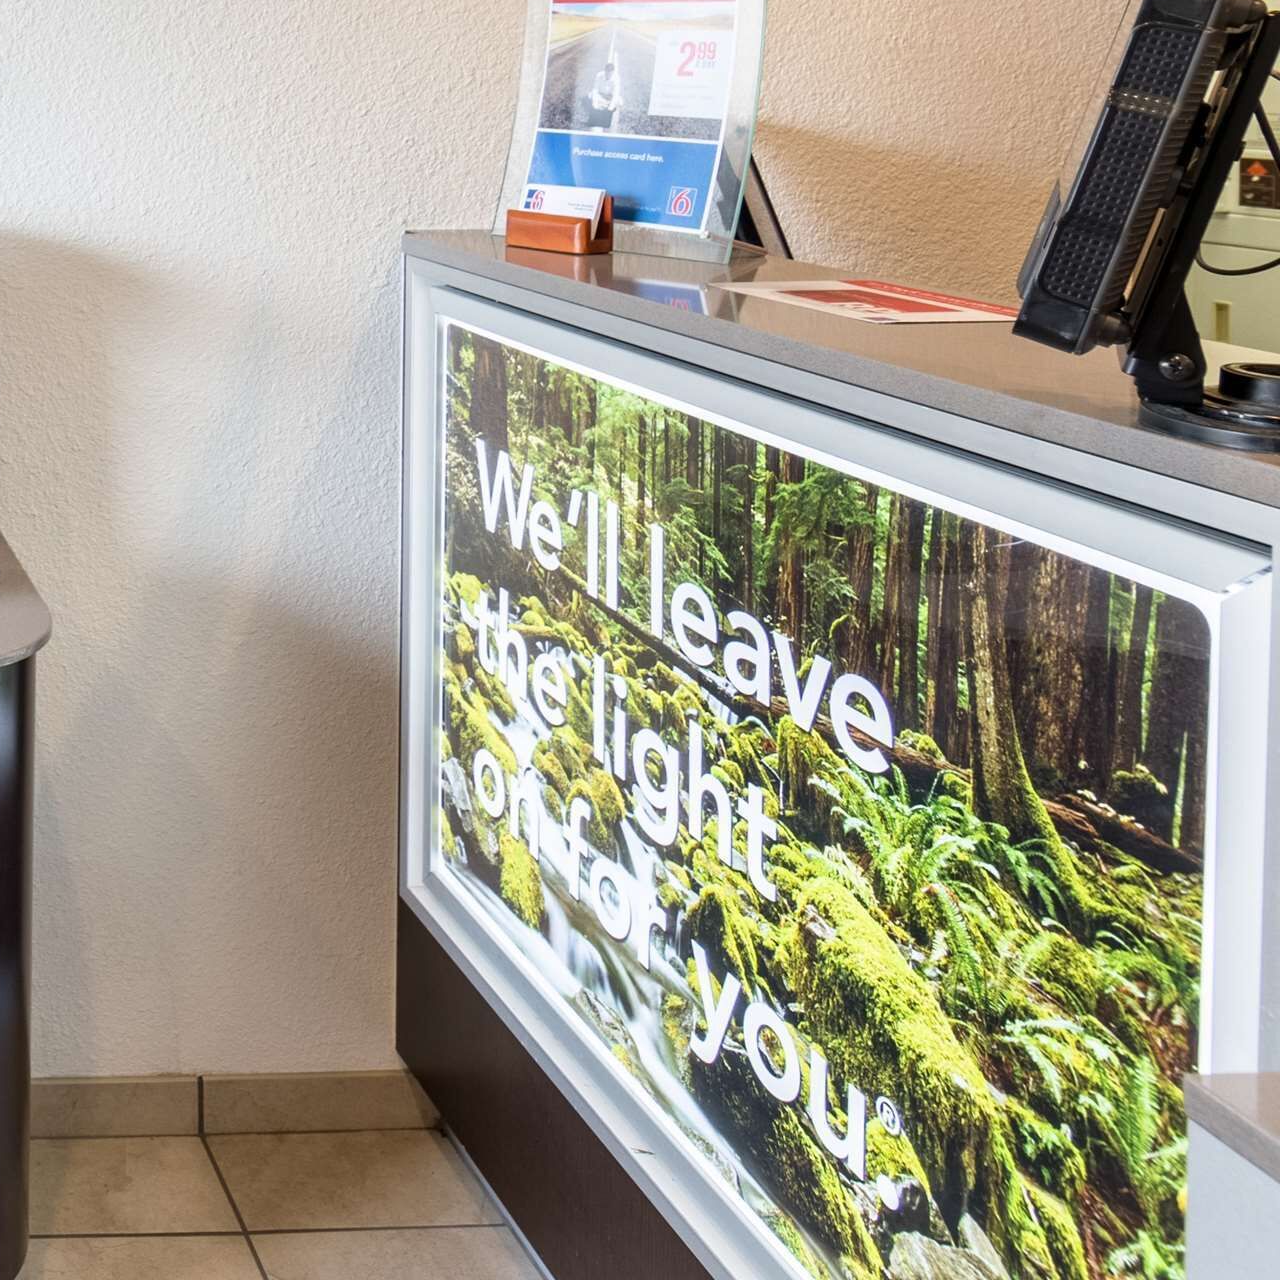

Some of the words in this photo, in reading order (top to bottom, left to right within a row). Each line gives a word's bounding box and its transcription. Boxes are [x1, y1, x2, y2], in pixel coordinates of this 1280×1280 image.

[573, 147, 603, 158] Purchase
[604, 151, 628, 161] access
[630, 152, 646, 162] card
[671, 188, 691, 216] 6
[475, 437, 620, 613] We'll
[649, 523, 895, 775] leave
[470, 586, 569, 727] the
[592, 655, 780, 903] light
[473, 746, 543, 862] on
[563, 796, 669, 969] for
